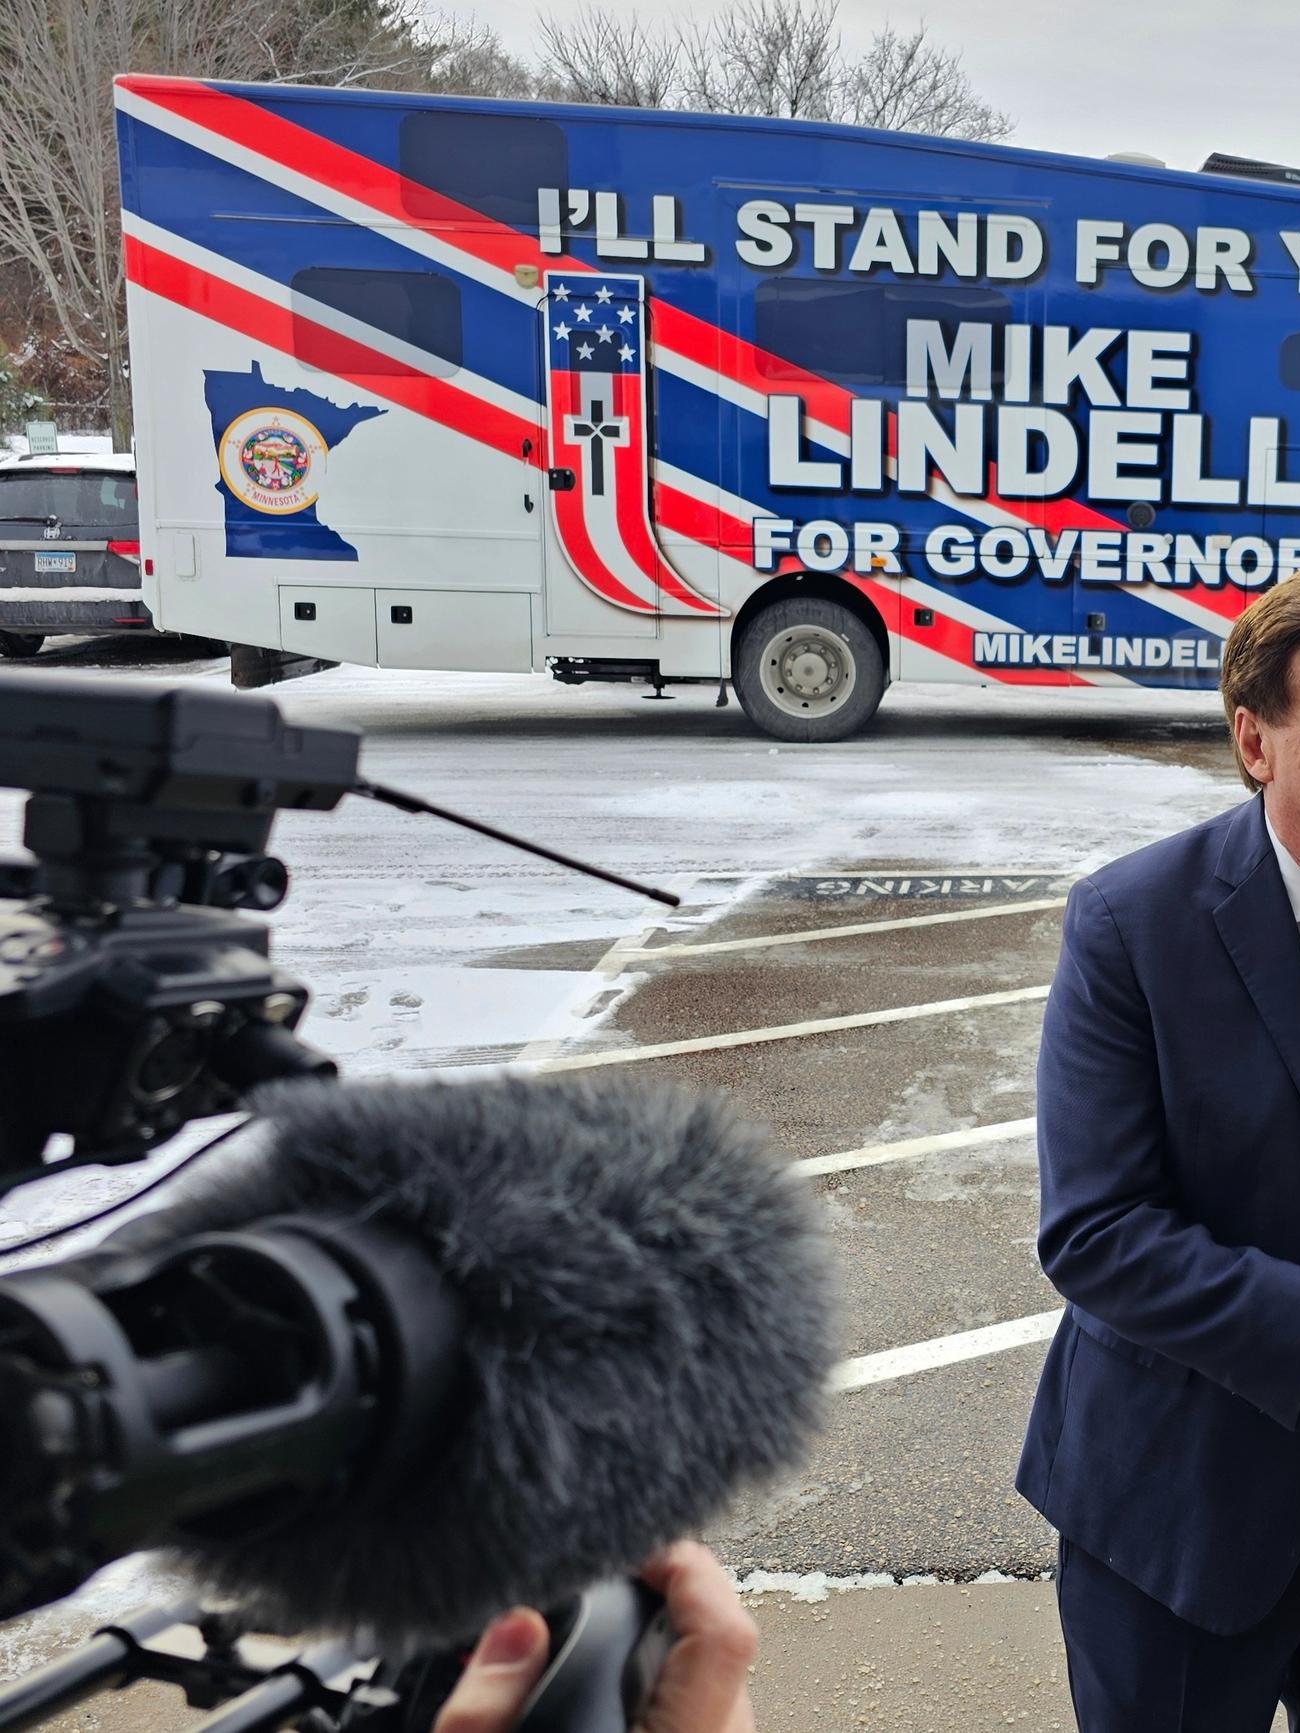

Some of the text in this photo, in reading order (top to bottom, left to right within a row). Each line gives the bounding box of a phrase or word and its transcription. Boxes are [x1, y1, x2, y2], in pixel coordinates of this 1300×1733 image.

[537, 187, 705, 262] I'LL
[734, 199, 1044, 279] STAND
[1074, 219, 1254, 293] FOR
[905, 318, 1192, 410] MIKE
[252, 491, 300, 505] MINNESOTA
[753, 517, 901, 574] FOR
[973, 632, 1227, 669] MIKELINDEL
[815, 878, 1060, 895] ARKING
